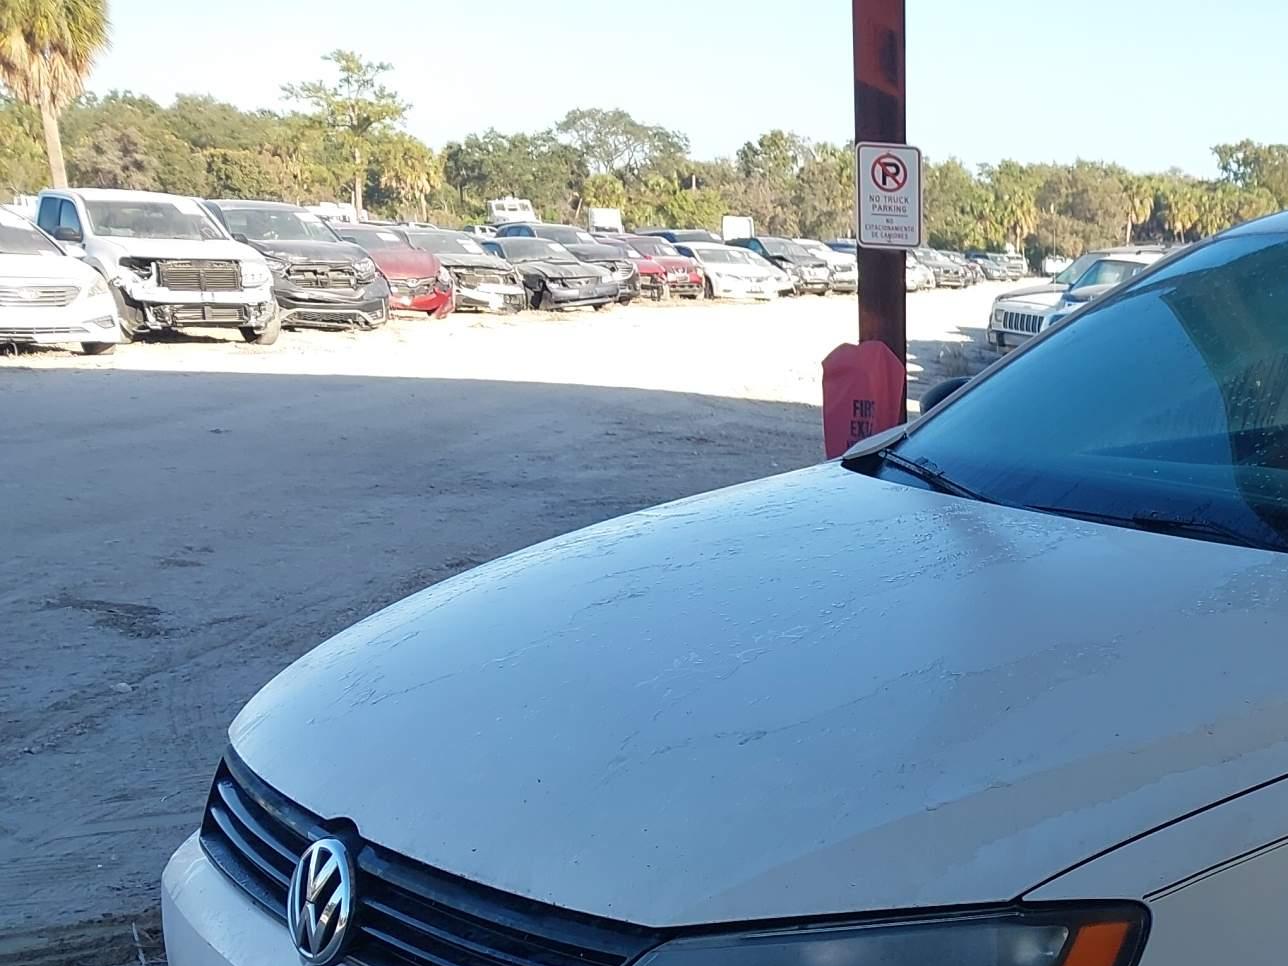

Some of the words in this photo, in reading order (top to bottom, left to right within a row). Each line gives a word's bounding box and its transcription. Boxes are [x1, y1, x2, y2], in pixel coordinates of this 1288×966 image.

[869, 194, 880, 203] NO
[884, 195, 909, 204] TRUCK
[872, 204, 907, 213] PARKING
